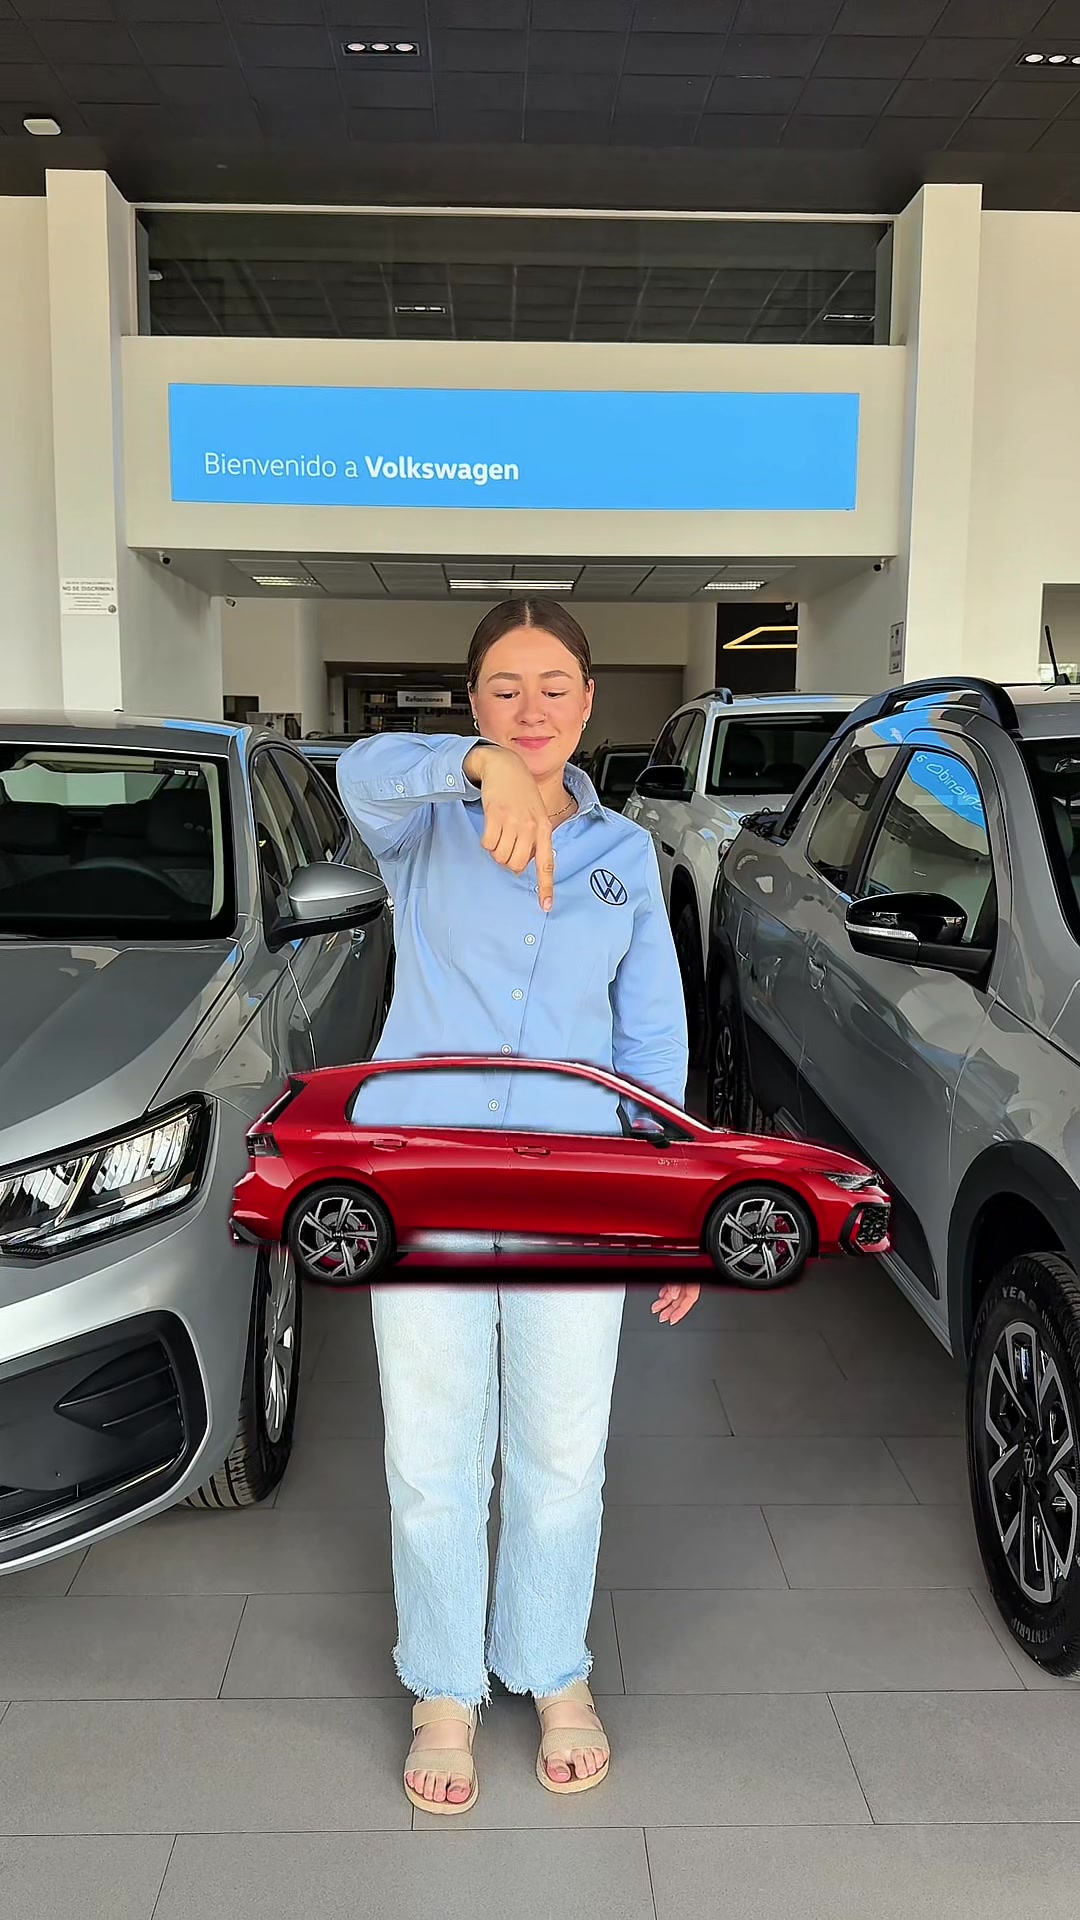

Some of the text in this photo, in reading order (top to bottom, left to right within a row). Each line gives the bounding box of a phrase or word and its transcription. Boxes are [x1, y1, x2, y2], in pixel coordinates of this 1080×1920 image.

[204, 452, 520, 486] Bienvenido a Volkswagen
[405, 695, 444, 703] Refacciones
